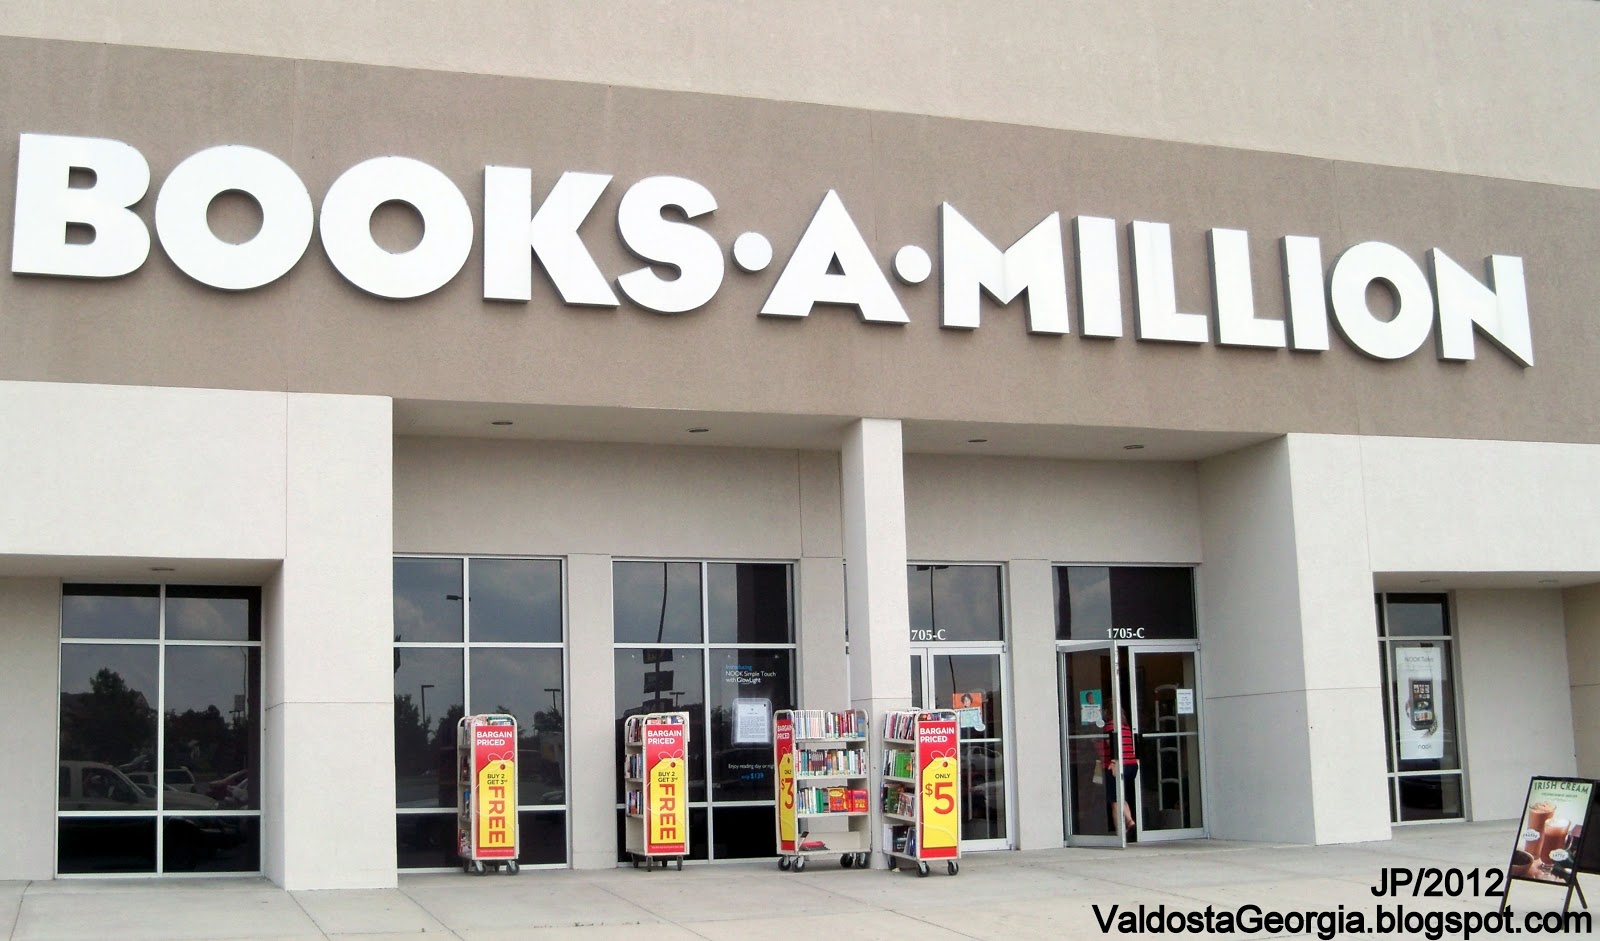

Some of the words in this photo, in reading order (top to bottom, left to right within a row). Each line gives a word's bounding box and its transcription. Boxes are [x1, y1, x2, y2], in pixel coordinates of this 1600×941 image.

[1106, 627, 1145, 639] 1705-C
[777, 732, 790, 740] PRICED
[919, 727, 955, 735] BARGAIN
[647, 737, 675, 745] PRICED
[1534, 781, 1557, 790] IRISH
[1560, 781, 1590, 794] CREAM
[488, 786, 506, 844] FREE
[659, 784, 676, 841] FREE
